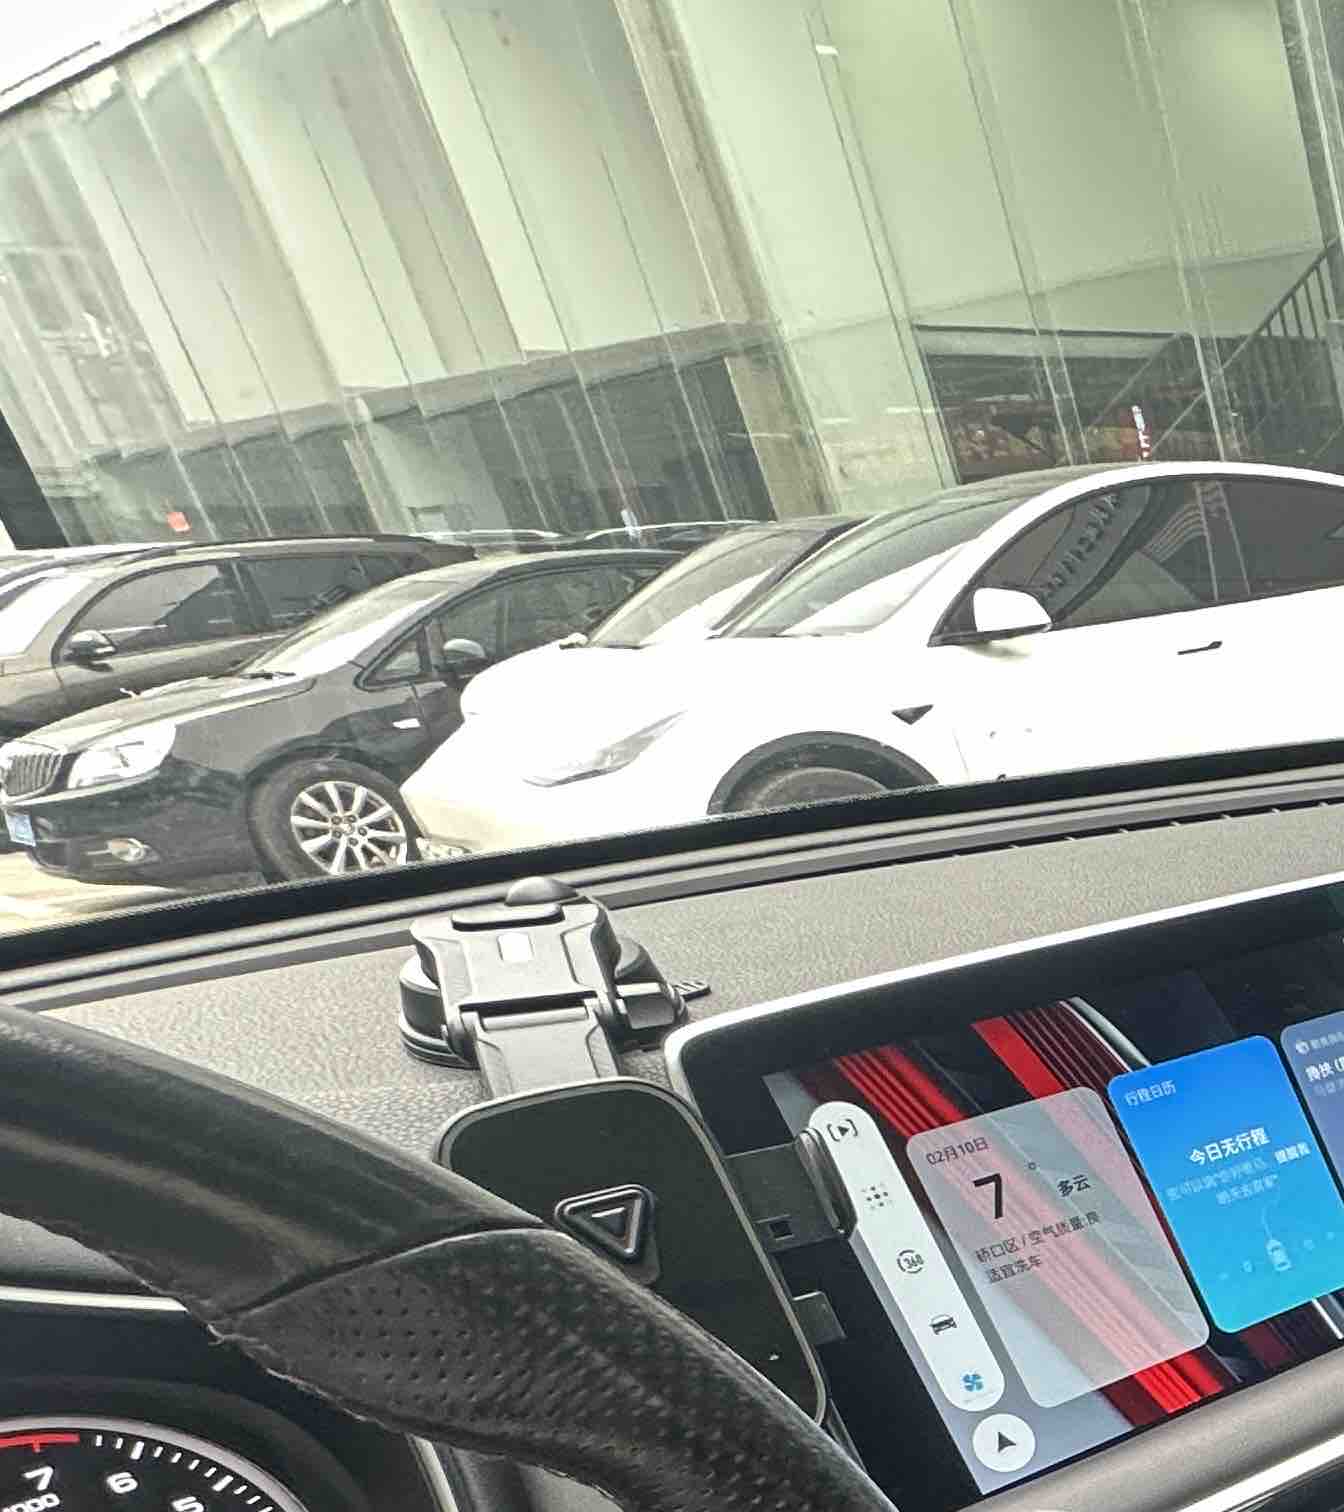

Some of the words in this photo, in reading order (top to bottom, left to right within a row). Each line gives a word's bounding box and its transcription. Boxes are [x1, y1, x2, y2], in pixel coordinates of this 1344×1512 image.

[1125, 1080, 1177, 1106] 行程日历
[926, 1136, 989, 1165] 02月10日
[1190, 1127, 1270, 1166] 今日无行程
[1056, 1174, 1091, 1198] 多云
[23, 1466, 54, 1490] 7
[106, 1472, 139, 1494] 6
